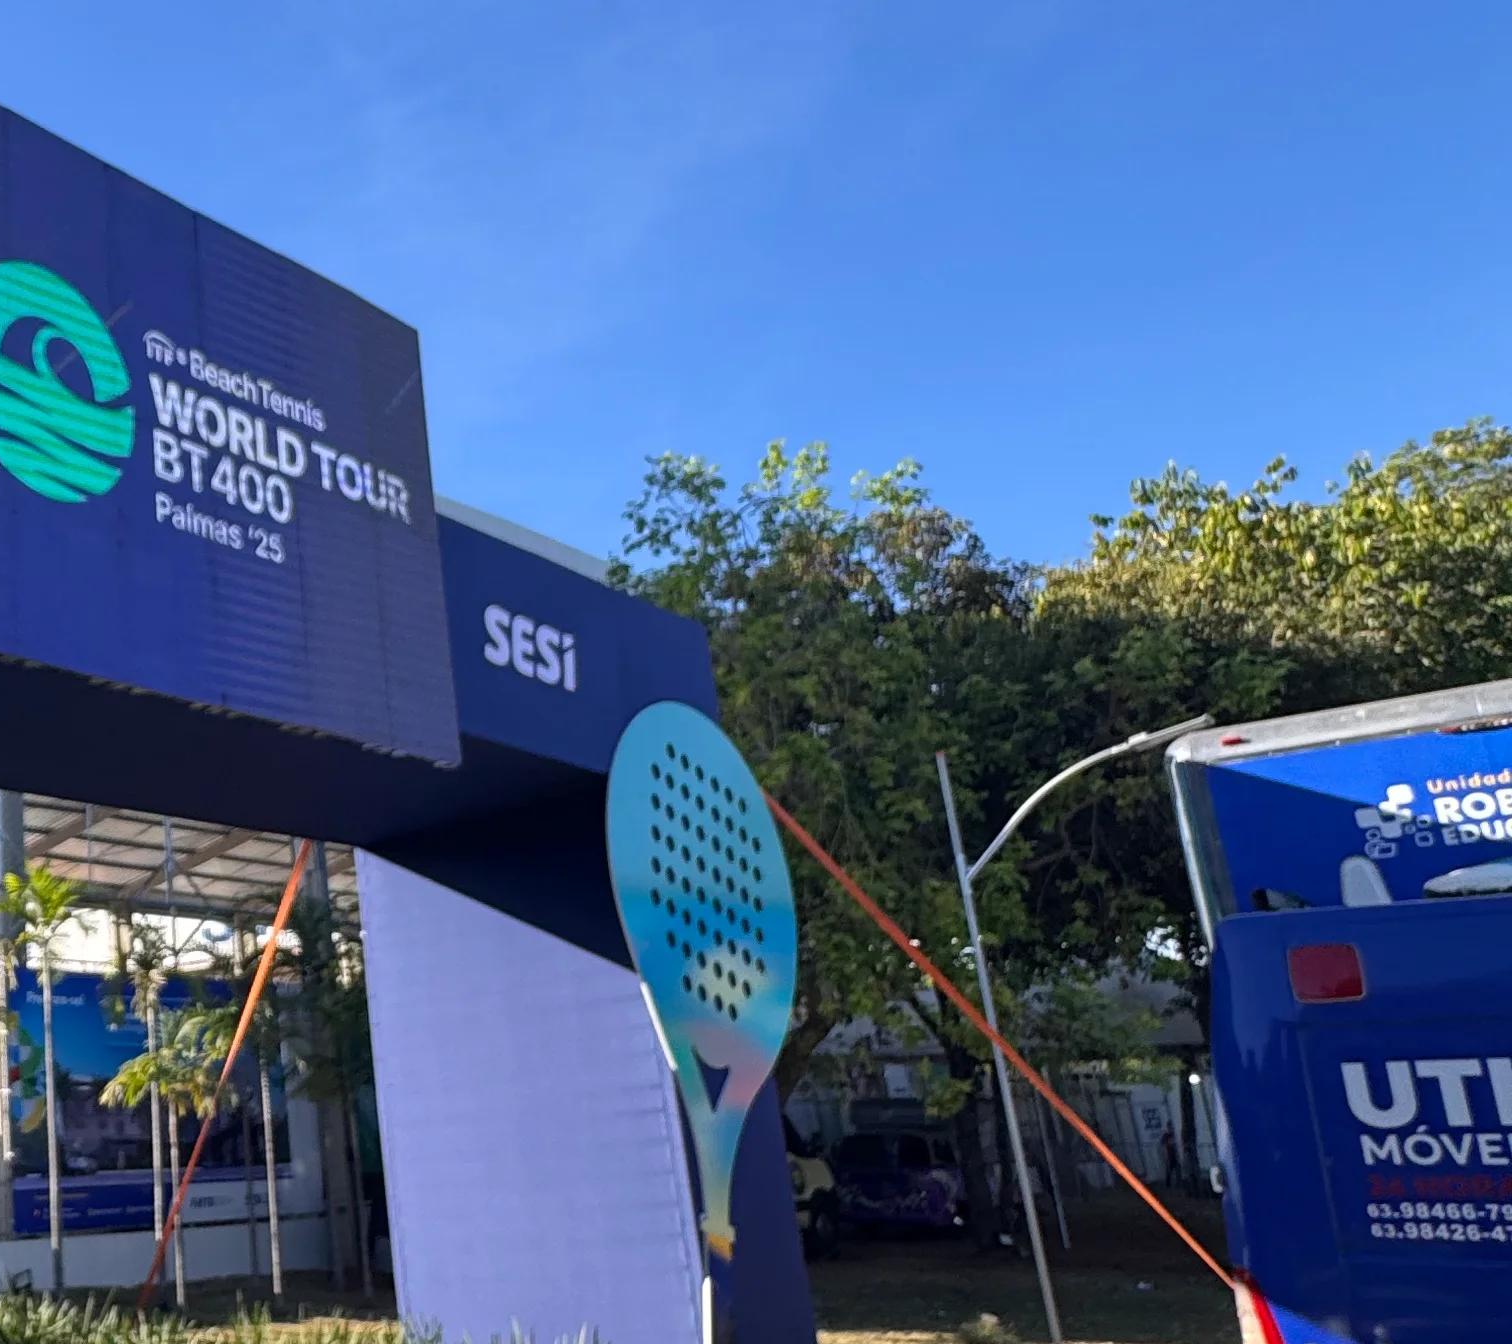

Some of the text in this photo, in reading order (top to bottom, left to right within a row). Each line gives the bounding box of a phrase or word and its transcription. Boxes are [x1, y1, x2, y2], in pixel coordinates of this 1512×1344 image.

[188, 347, 260, 405] Beach
[256, 377, 327, 432] Tennis
[148, 372, 412, 525] WORLD TOUR
[155, 491, 244, 550] Palmas
[1359, 1124, 1512, 1166] MÓVE
